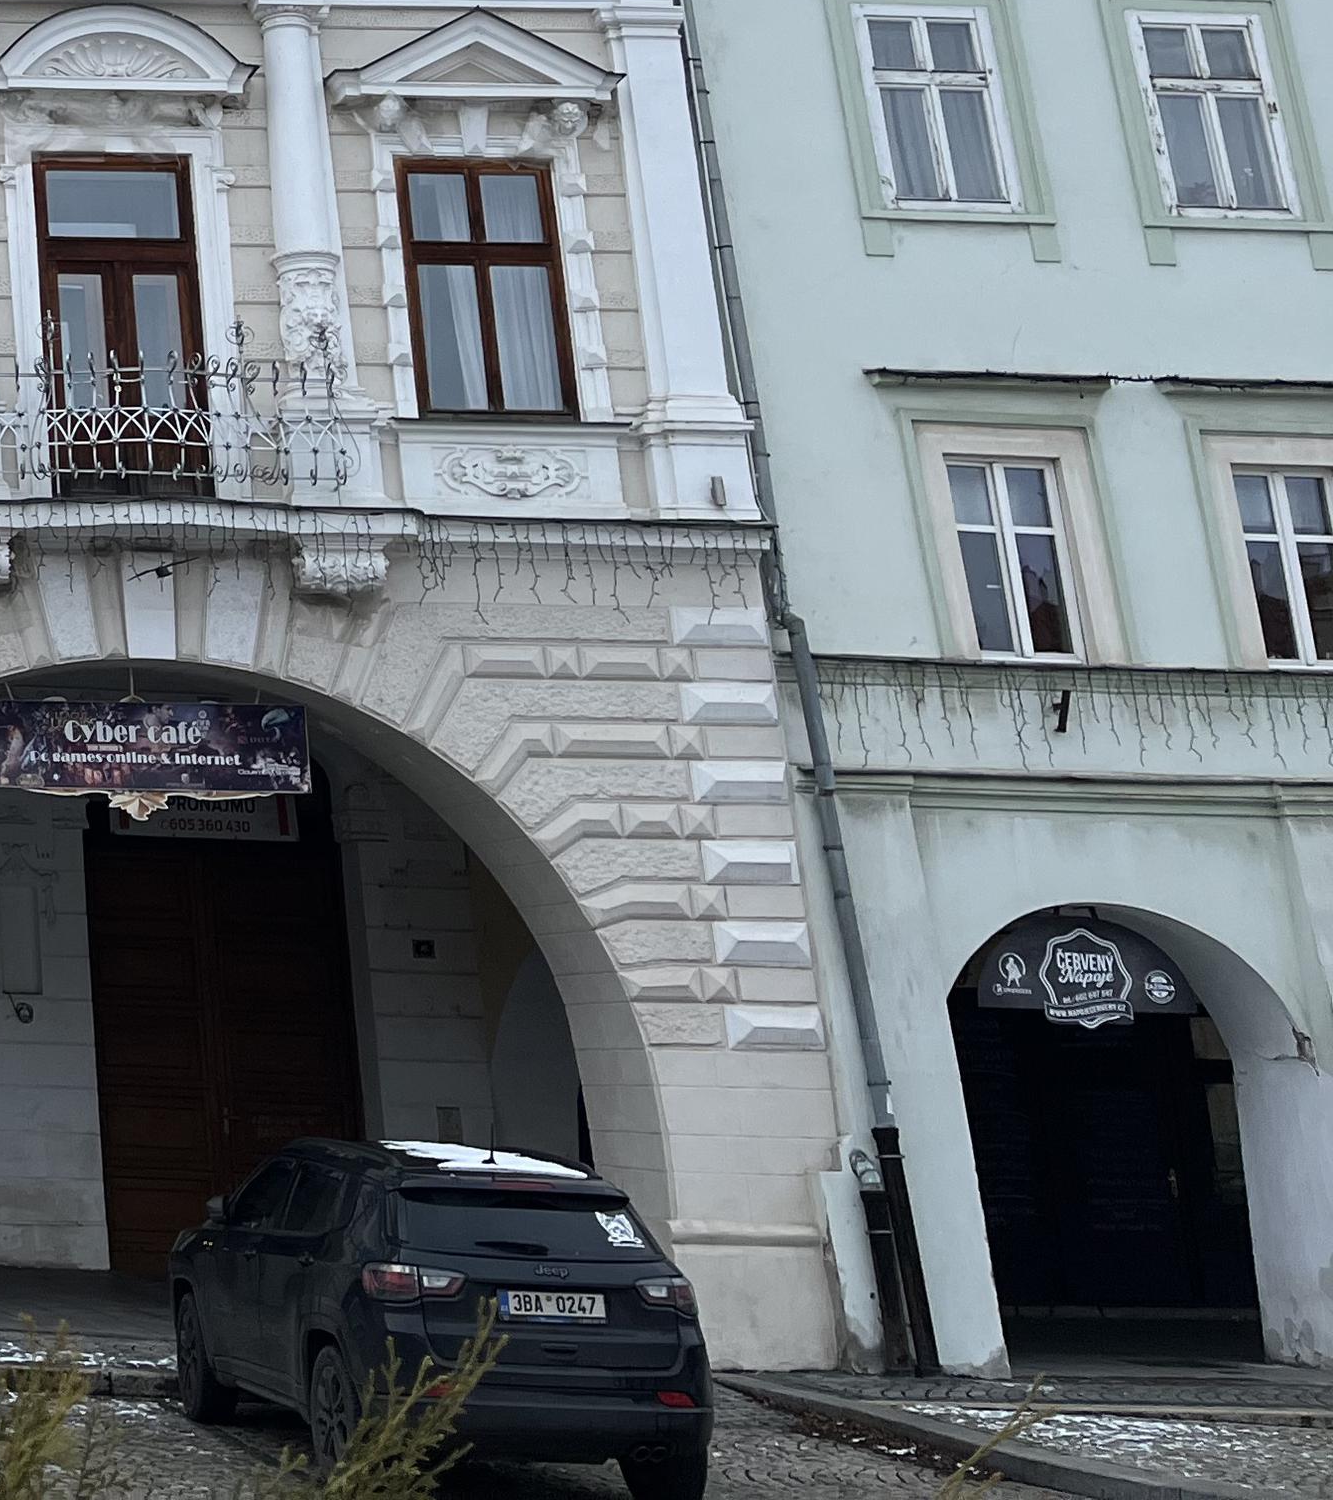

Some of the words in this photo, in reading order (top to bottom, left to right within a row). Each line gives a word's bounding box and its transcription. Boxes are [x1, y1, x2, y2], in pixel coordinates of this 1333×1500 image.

[64, 719, 141, 743] Cyber
[147, 720, 203, 744] café
[226, 820, 250, 833] 430
[1056, 947, 1114, 972] ČERVENÝ
[1058, 966, 1115, 988] Nápoje
[534, 1263, 570, 1279] Jeep
[512, 1293, 544, 1313] 3BA
[556, 1295, 596, 1315] 0247
